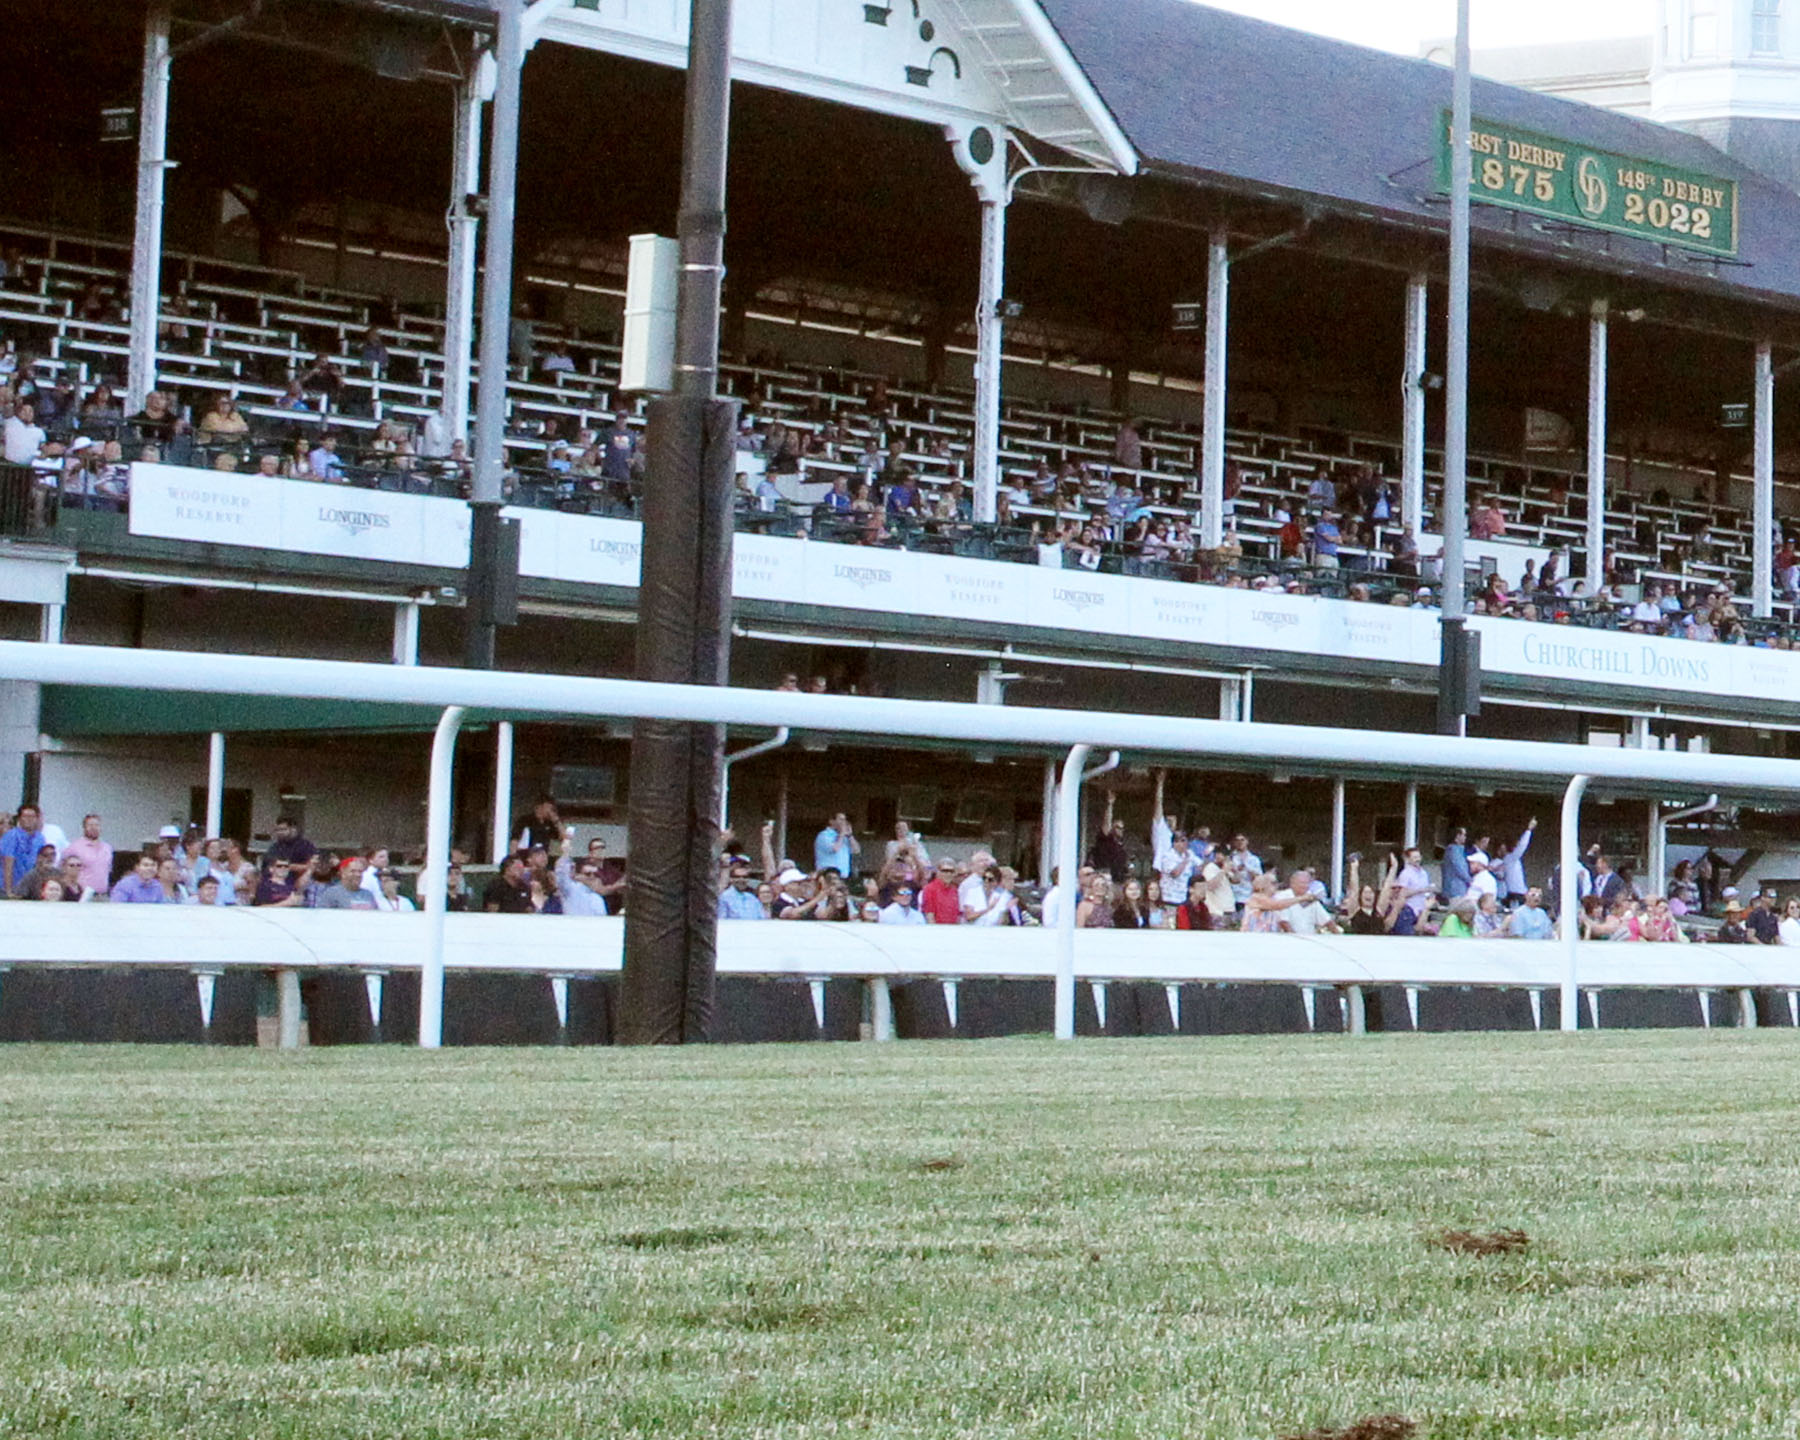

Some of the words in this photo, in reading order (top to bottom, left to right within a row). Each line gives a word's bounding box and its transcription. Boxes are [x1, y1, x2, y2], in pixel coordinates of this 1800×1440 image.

[1447, 126, 1502, 156] RST
[1507, 140, 1566, 171] DERBY
[1468, 158, 1555, 202] 875
[1662, 178, 1724, 208] DERBY
[1624, 193, 1711, 238] 2022
[168, 487, 251, 508] WOODFORD
[176, 507, 244, 525] RESERVE
[318, 507, 392, 529] LONGINES
[590, 538, 641, 555] LONGIN
[833, 563, 893, 583] LONGINES
[1052, 587, 1105, 605] LONGINES
[1250, 608, 1300, 626] LONGINES
[1522, 632, 1633, 674] CHURCHILL
[1640, 645, 1710, 682] DOWNS
